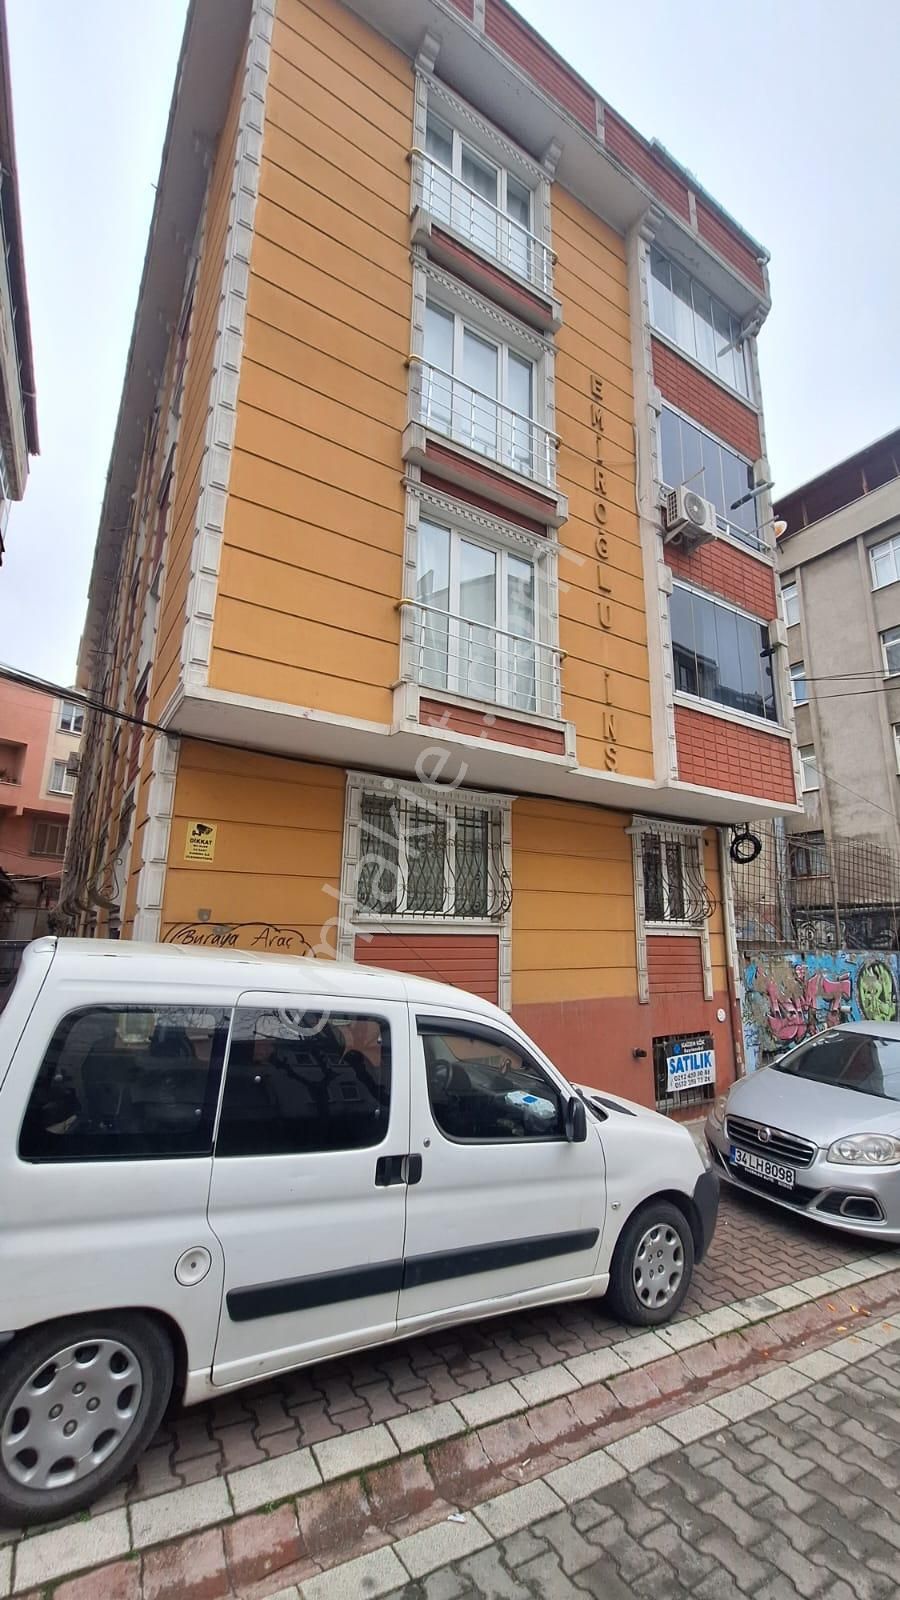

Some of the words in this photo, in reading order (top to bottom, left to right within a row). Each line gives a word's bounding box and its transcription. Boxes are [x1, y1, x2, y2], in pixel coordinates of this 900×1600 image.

[178, 929, 240, 948] Buraya
[251, 927, 296, 949] Araç
[669, 1052, 712, 1074] SATILIK
[735, 1150, 748, 1165] 34
